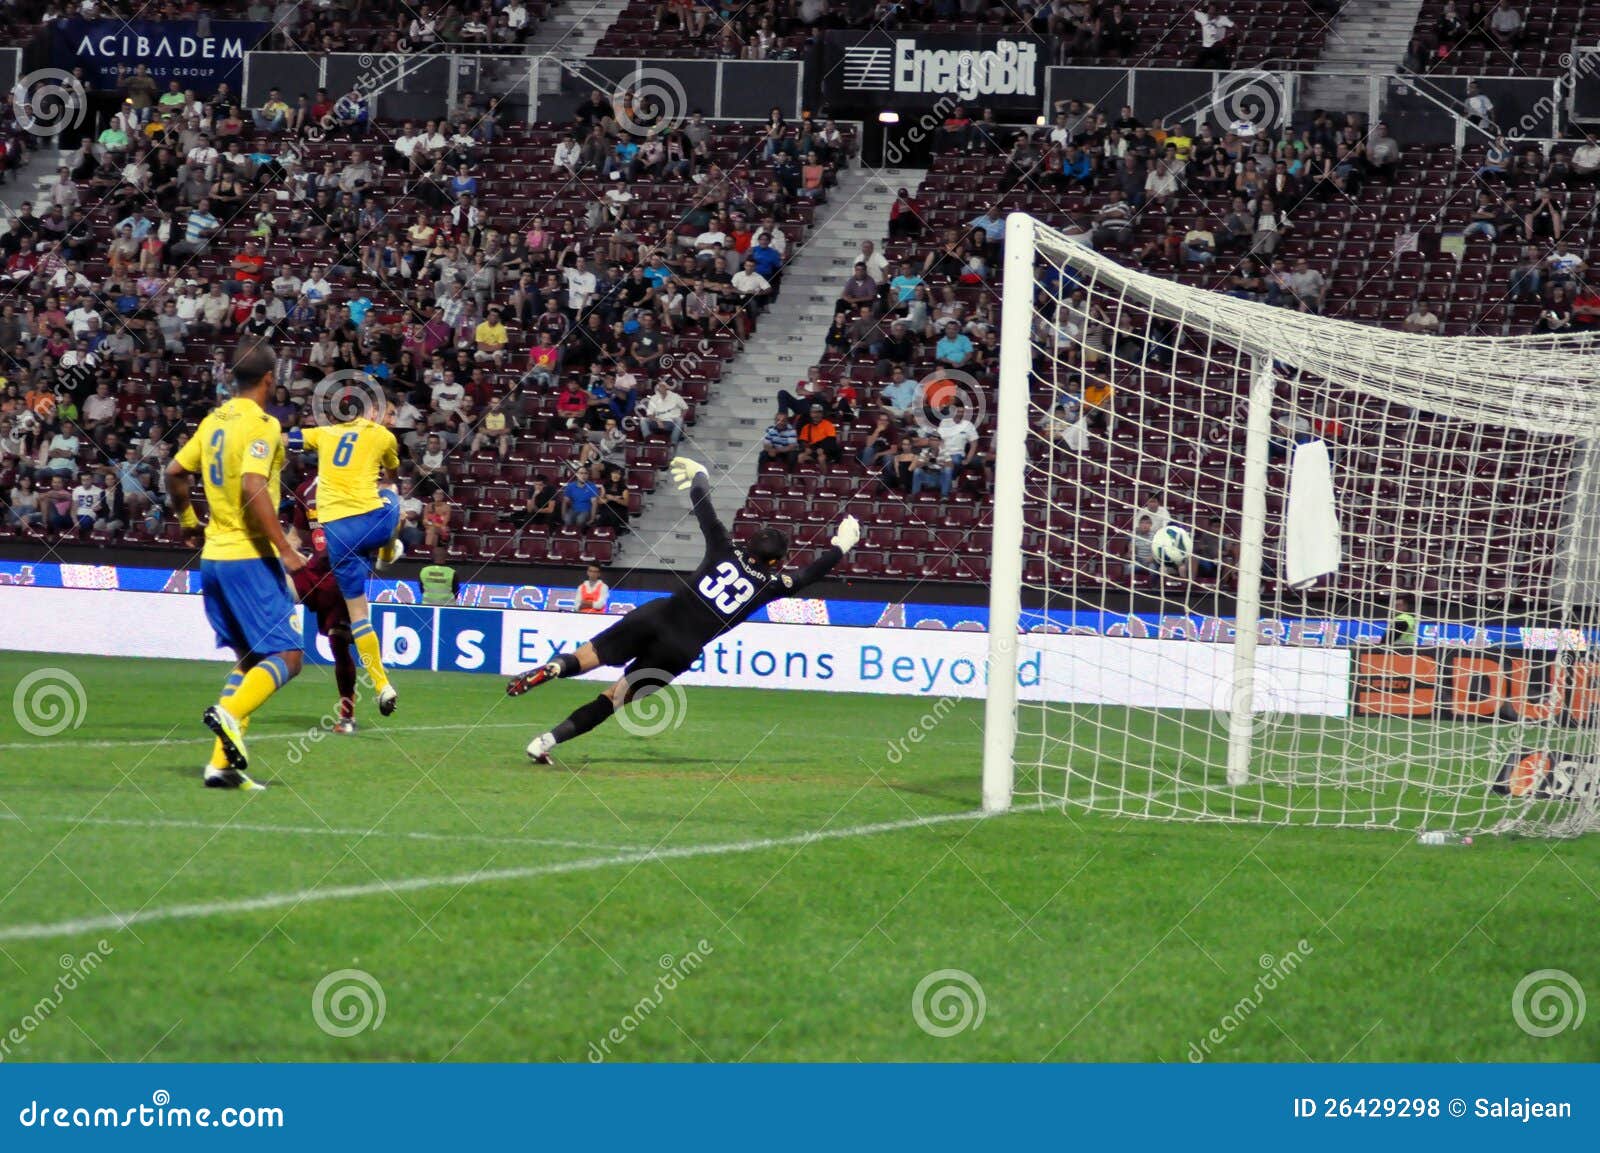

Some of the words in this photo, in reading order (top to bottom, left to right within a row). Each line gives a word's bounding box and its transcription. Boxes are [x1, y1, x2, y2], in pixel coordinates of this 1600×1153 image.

[76, 35, 243, 58] ACIBADEM
[172, 68, 215, 77] GROUP
[893, 39, 1037, 100] EnergoBit
[210, 429, 224, 486] 3
[333, 432, 358, 467] 6
[698, 562, 755, 615] 33
